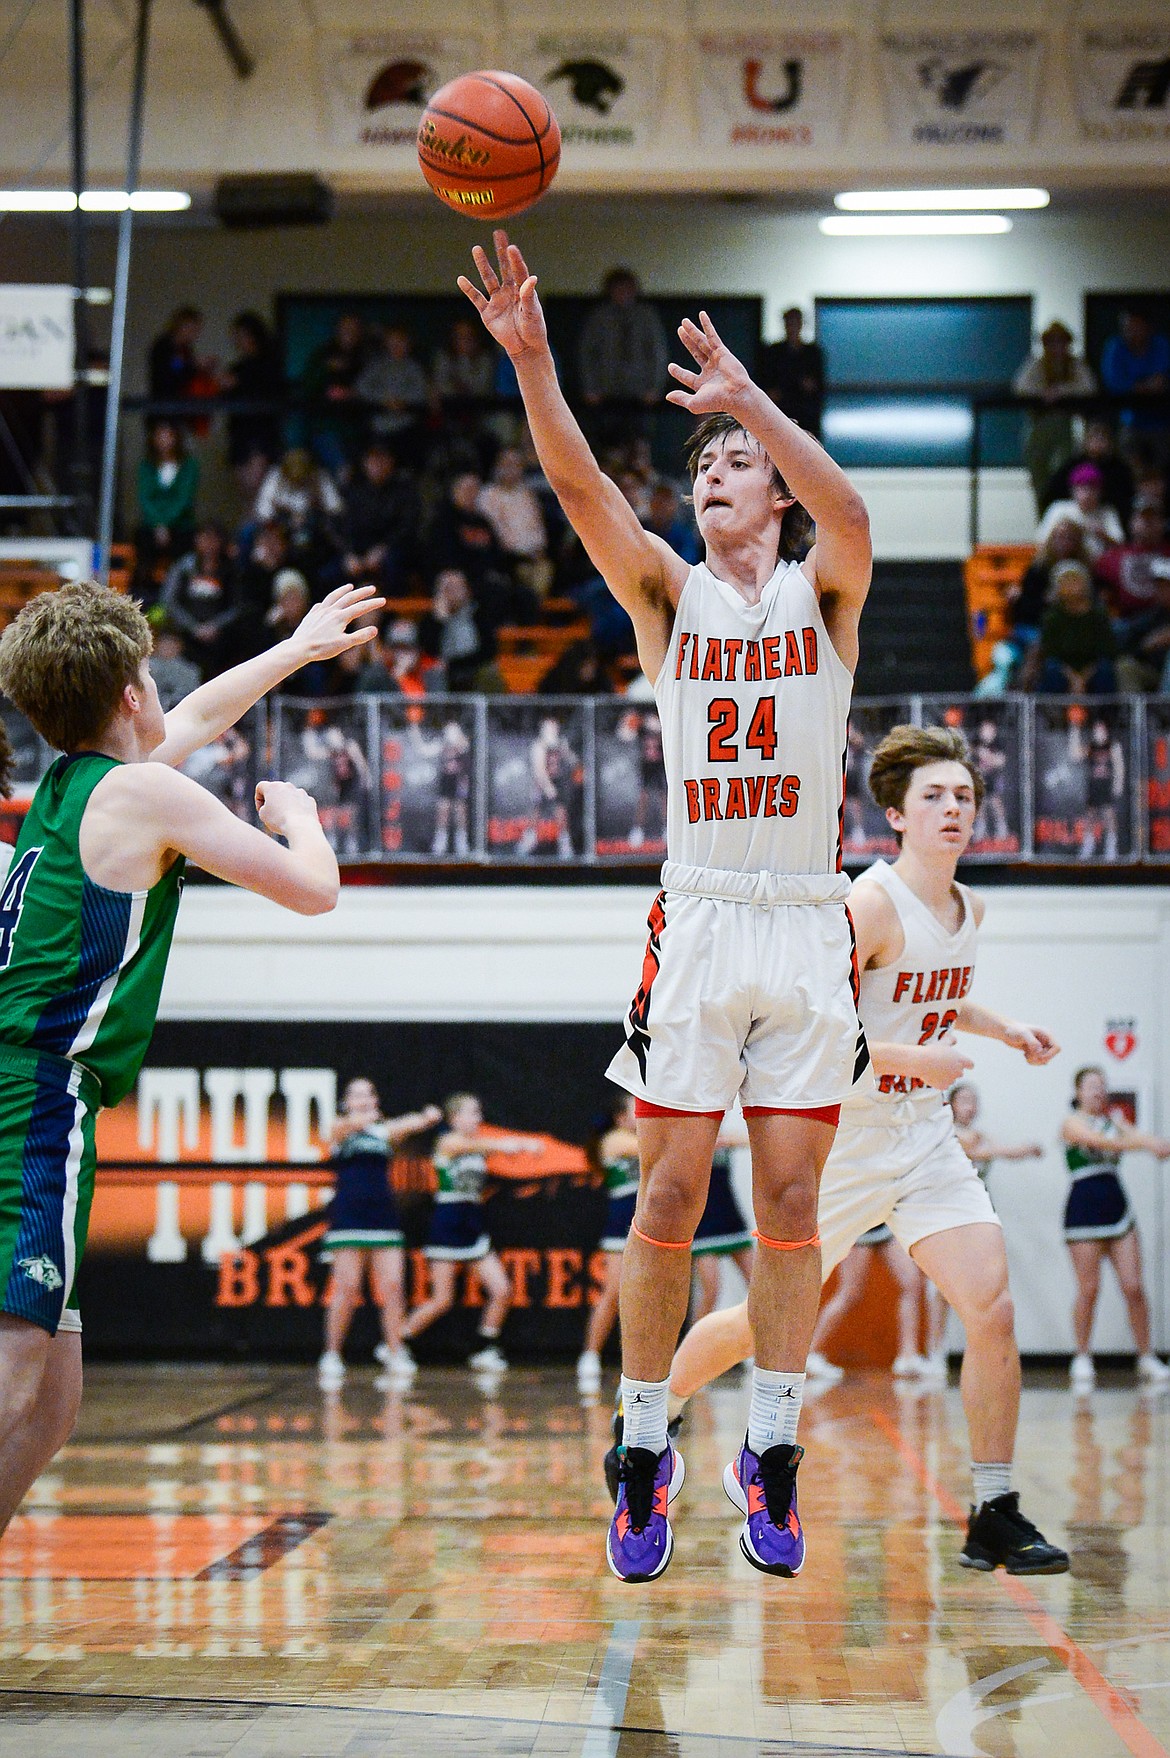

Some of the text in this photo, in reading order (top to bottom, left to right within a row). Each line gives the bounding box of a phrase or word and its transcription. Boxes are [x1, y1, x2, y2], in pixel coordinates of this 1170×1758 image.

[675, 626, 818, 681] FLATHEAD
[707, 695, 778, 763] 24
[684, 773, 801, 824] BRAVES
